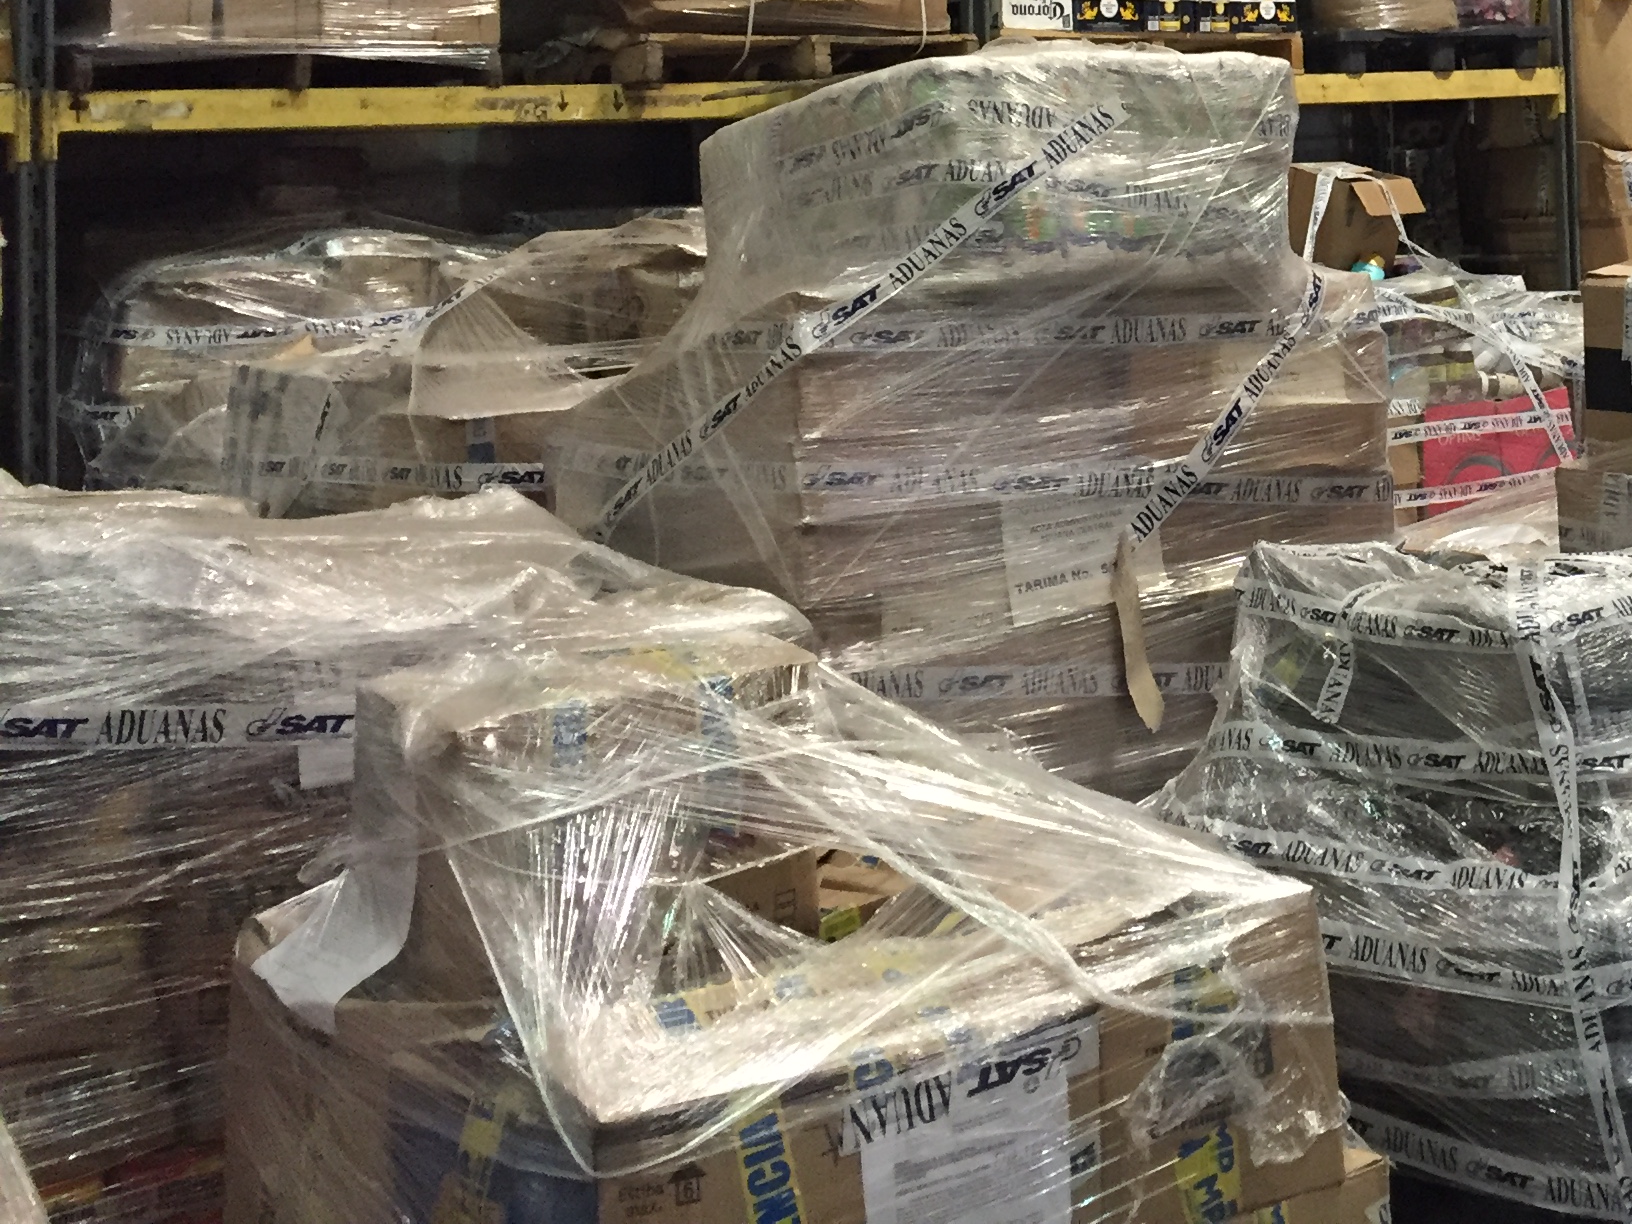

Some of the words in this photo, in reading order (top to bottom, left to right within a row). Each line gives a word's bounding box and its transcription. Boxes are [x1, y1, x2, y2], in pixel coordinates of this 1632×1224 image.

[1011, 1, 1065, 20] Corona
[969, 99, 1057, 129] ADUANAS
[831, 283, 882, 327] SAT
[888, 216, 968, 290] ADUANAS
[991, 158, 1040, 203] SAT
[1039, 104, 1115, 169] ADUANAS
[1308, 270, 1322, 308] SAT
[165, 328, 231, 345] ADUANAS
[1110, 316, 1188, 344] ADUANAS
[1216, 319, 1261, 336] SAT
[711, 392, 742, 428] SAT
[744, 336, 803, 401] ADUANAS
[1213, 397, 1244, 446] SAT
[1243, 333, 1296, 402] ADUANAS
[1393, 431, 1415, 440] SAT
[1461, 422, 1482, 430] SAT
[497, 470, 546, 484] SAT
[1232, 478, 1302, 503] ADUANAS
[1325, 485, 1370, 499] SAT
[1407, 493, 1428, 501] SAT
[1477, 483, 1501, 492] SAT
[1129, 465, 1200, 542] ADUANAS
[1015, 573, 1068, 594] TARIMA
[1249, 587, 1297, 616] ADUANAS
[1309, 607, 1337, 624] SAT
[1419, 626, 1460, 642] SAT
[1566, 607, 1605, 626] SAT
[1528, 655, 1556, 713] SAT
[1, 717, 89, 738] SAT
[96, 708, 227, 746] ADUANAS
[276, 714, 355, 735] SAT
[1282, 739, 1322, 756] SAT
[1329, 742, 1402, 767] ADUANAS
[1424, 754, 1467, 769] SAT
[1582, 754, 1631, 769] SAT
[1281, 841, 1363, 873] ADUANAS
[1348, 934, 1429, 973] ADUANAS
[966, 1047, 1052, 1098] SAT
[1383, 1126, 1458, 1172] ADUANAS
